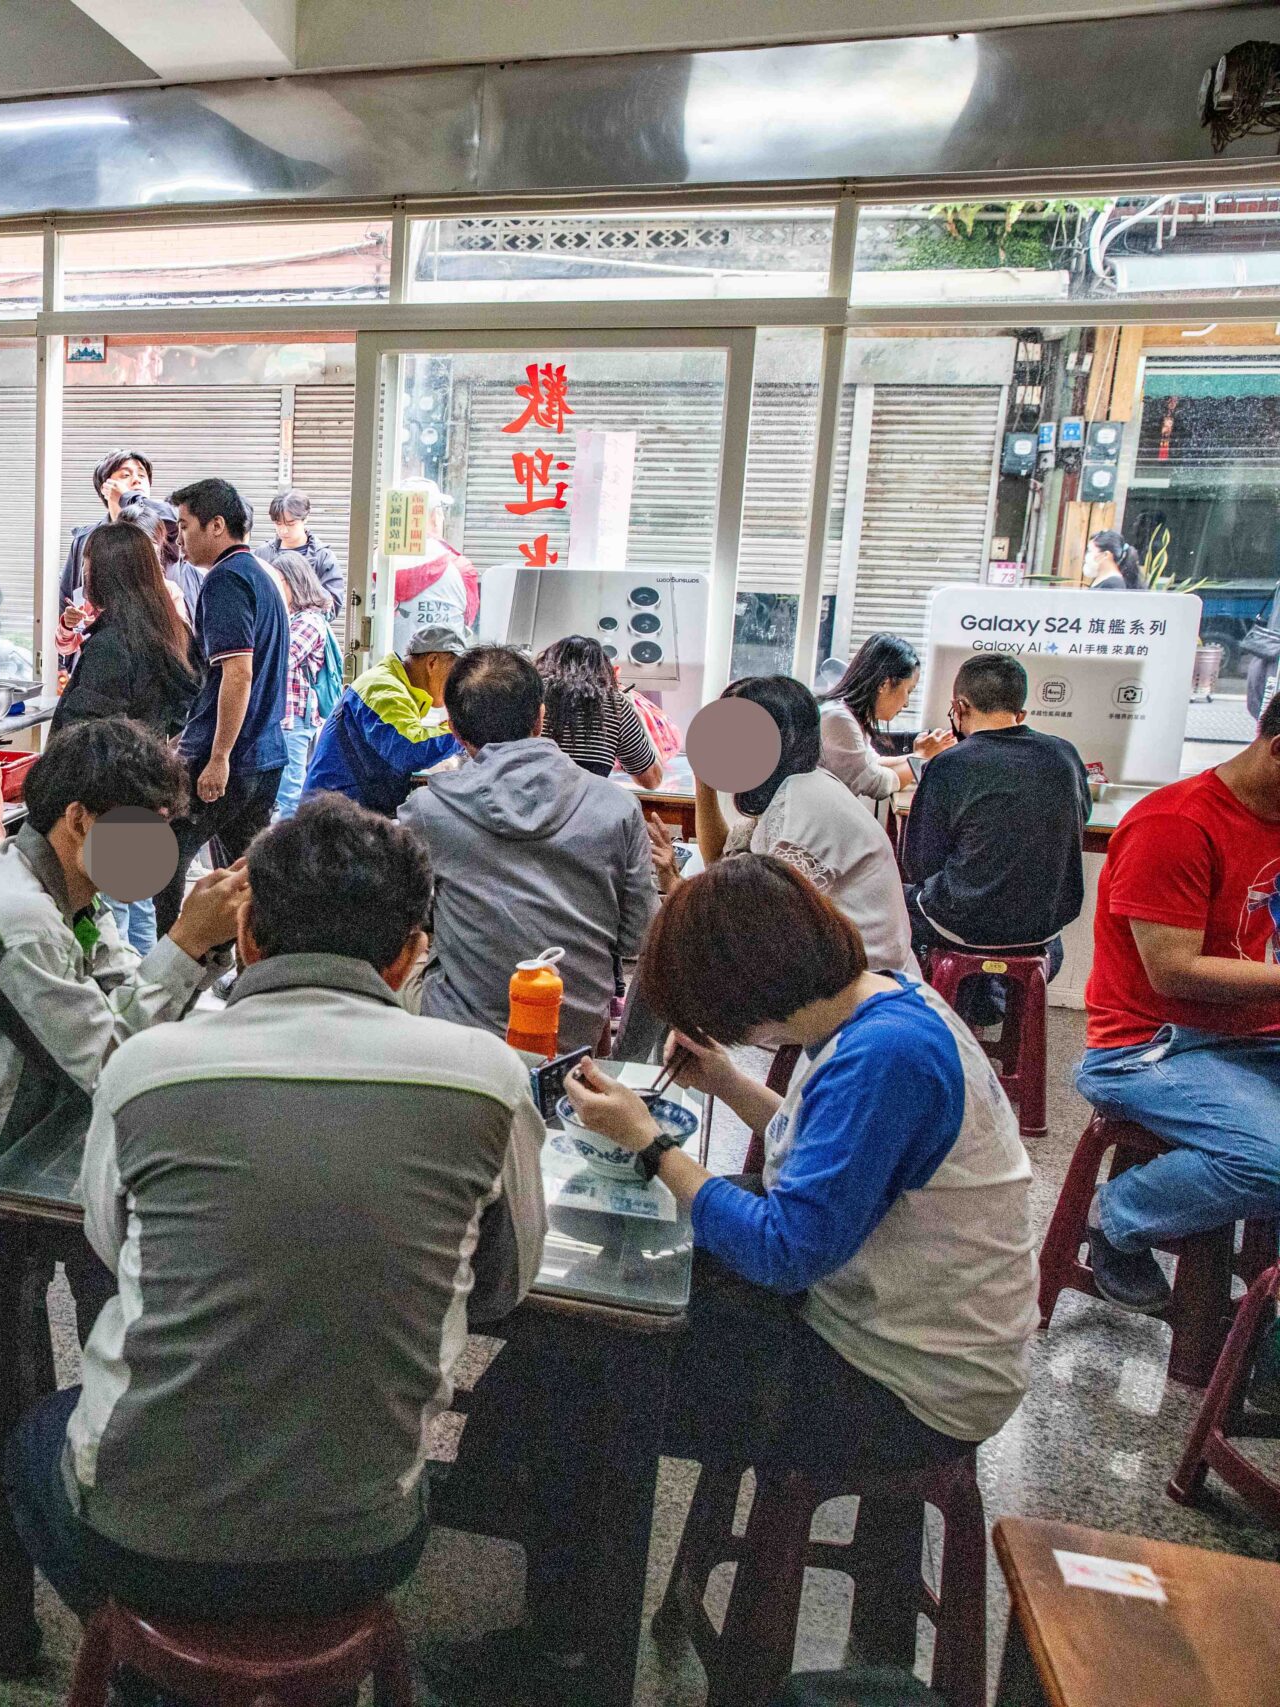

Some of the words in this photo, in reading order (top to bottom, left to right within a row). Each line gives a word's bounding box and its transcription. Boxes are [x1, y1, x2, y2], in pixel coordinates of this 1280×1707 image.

[1001, 573, 1015, 583] 73
[417, 613, 450, 623] 2024
[960, 614, 1040, 636] Galaxy
[1044, 617, 1082, 634] S24
[1088, 618, 1168, 636] 旗艦系列
[972, 640, 1024, 656] Galaxy
[1028, 643, 1041, 653] AI
